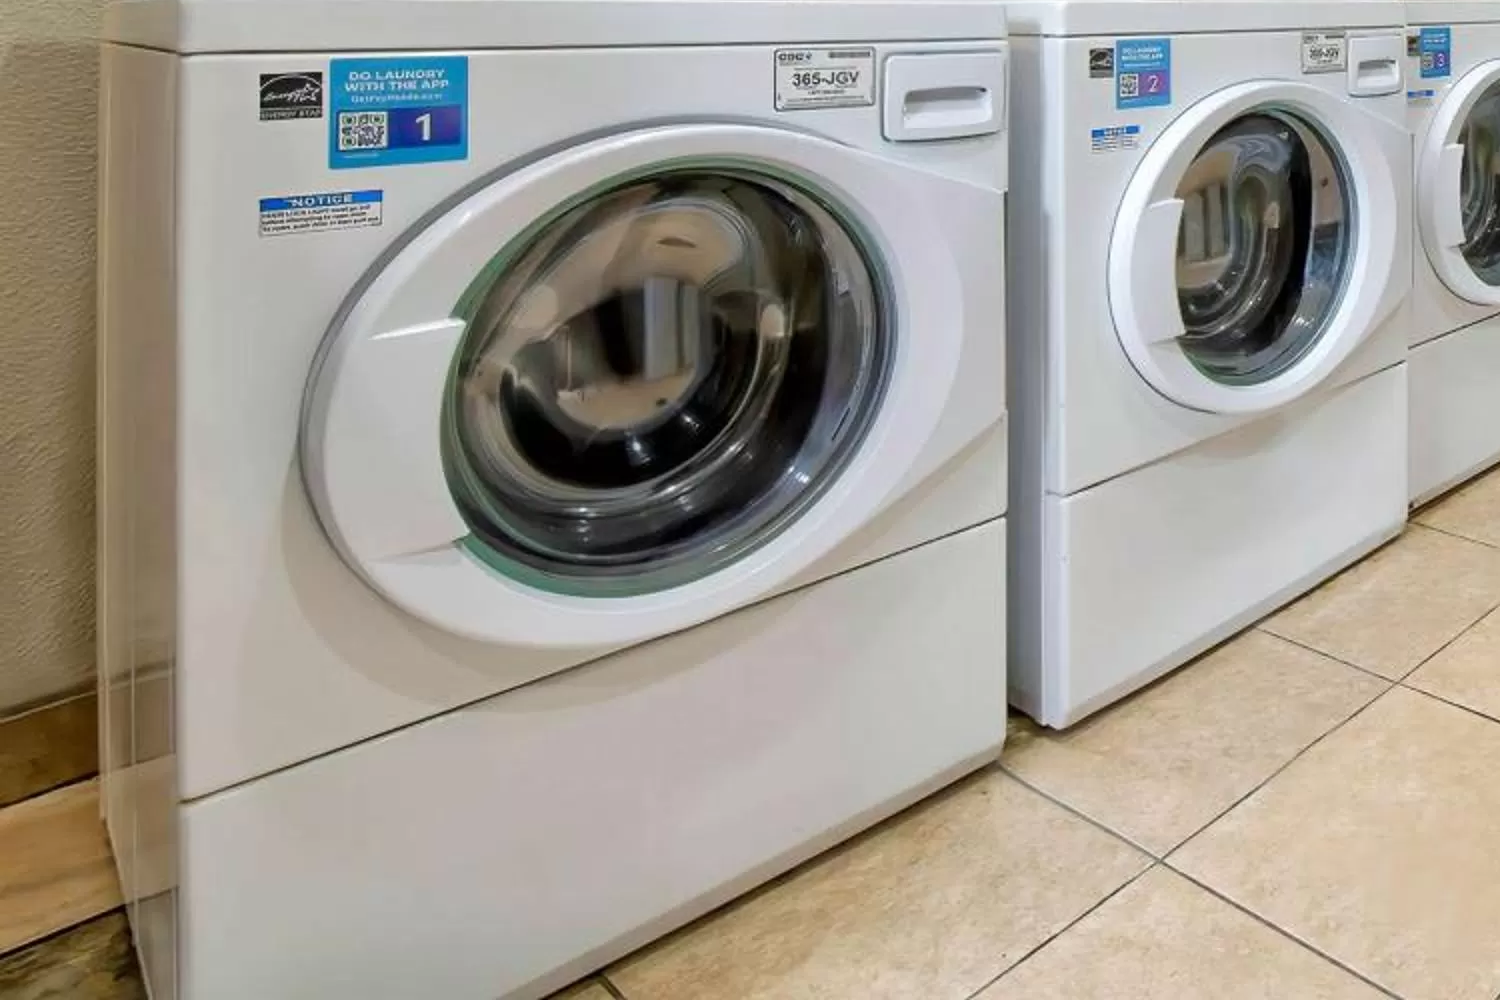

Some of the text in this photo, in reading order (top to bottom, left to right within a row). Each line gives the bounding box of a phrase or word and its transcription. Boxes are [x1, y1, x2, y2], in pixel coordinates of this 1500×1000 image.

[349, 69, 445, 81] DO LAUNDRY
[345, 79, 449, 92] WITH THE APP
[1148, 75, 1160, 92] 2
[415, 113, 431, 141] 1
[290, 194, 353, 208] NOTICE
